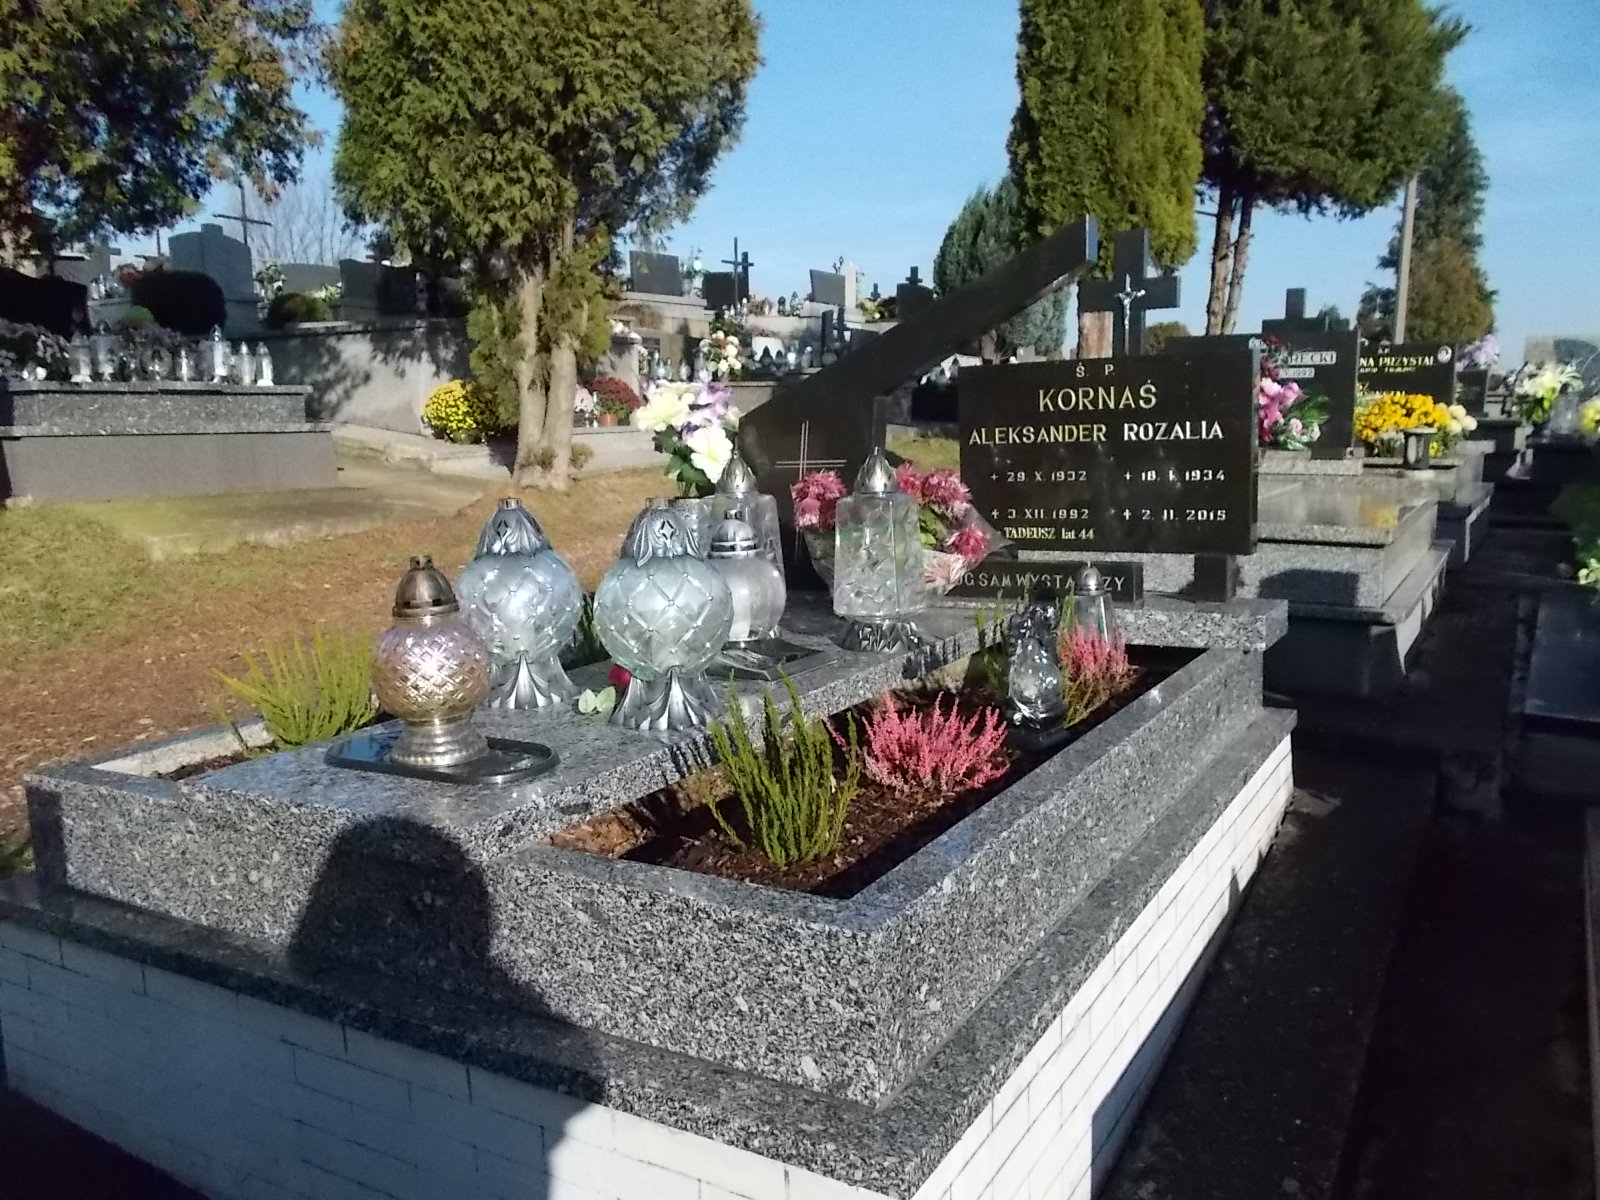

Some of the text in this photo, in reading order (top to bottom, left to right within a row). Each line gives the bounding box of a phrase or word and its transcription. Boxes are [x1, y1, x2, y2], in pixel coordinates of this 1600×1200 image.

[1038, 379, 1158, 412] KORNAŚ
[968, 420, 1224, 445] ALEKSANDER ROZALIA
[1051, 470, 1087, 482] 1932
[1185, 469, 1225, 481] 1934
[1052, 508, 1089, 519] 1992
[1186, 509, 1226, 521] 2015
[1004, 526, 1095, 539] TADEUSZ lat 44
[978, 572, 1011, 587] SAM
